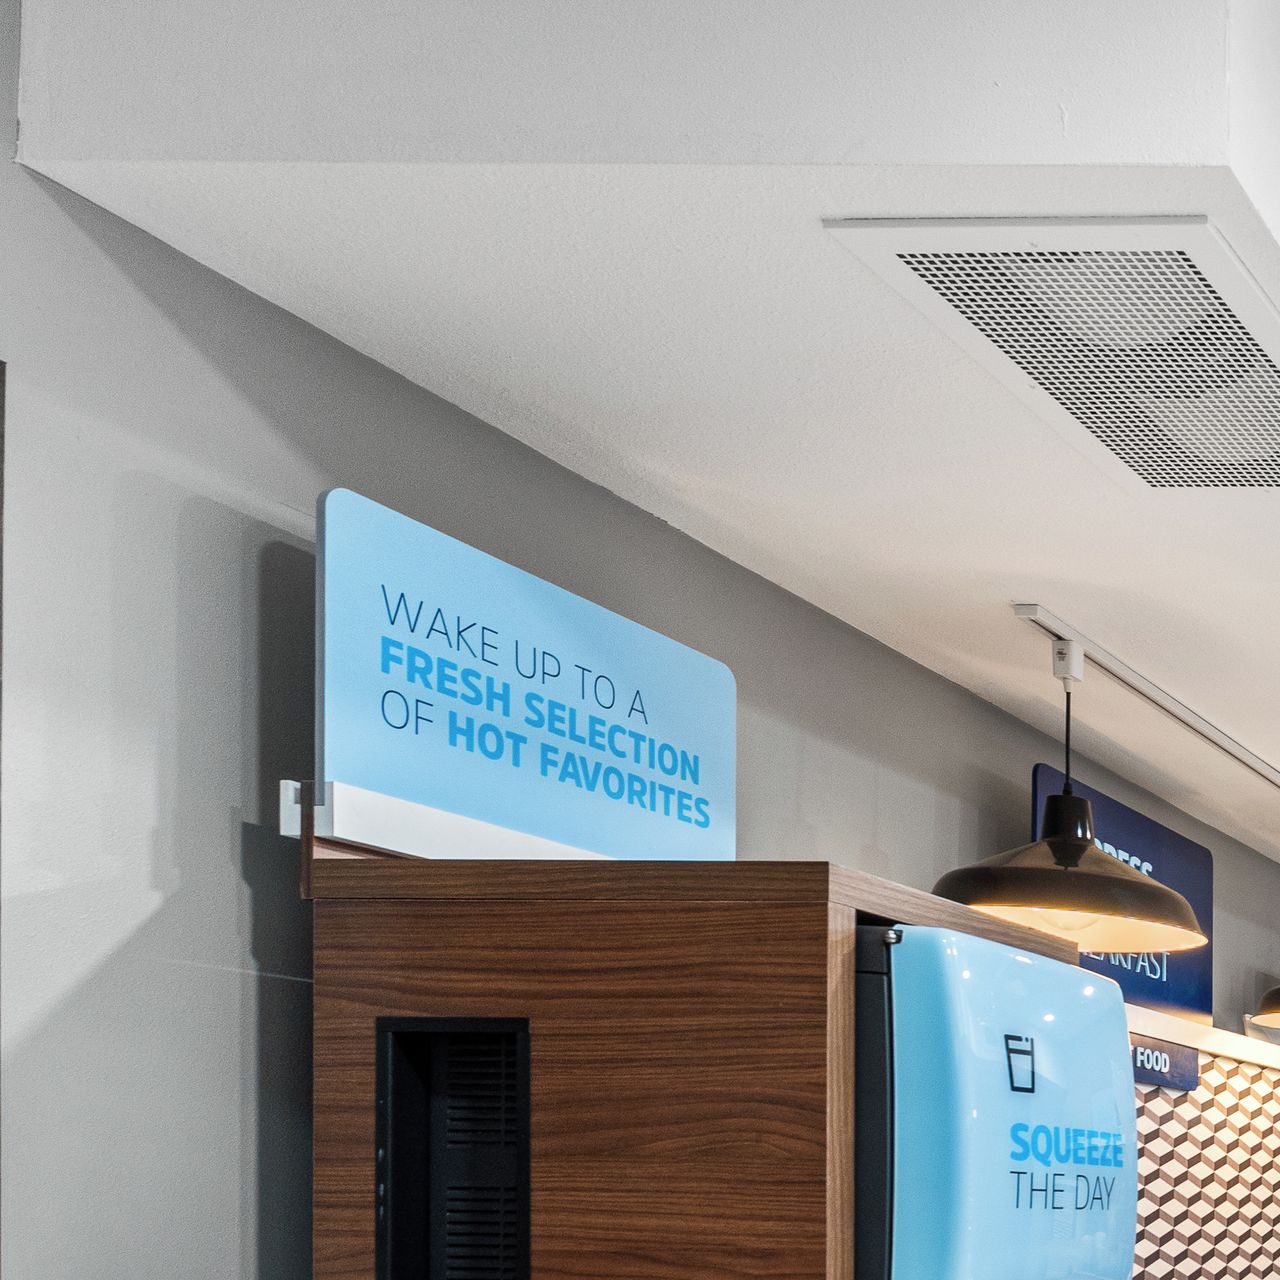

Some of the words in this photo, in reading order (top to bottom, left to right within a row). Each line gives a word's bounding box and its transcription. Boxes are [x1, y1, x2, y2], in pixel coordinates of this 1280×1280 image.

[381, 583, 499, 667] WAKE
[515, 639, 561, 685] UP
[574, 663, 616, 710] TO
[628, 689, 648, 725] A
[380, 635, 511, 718] FRESH
[524, 692, 700, 786] SELECTION
[381, 689, 434, 735] OF
[448, 710, 528, 768] HOT
[540, 742, 711, 829] FAVORITES
[1136, 1046, 1170, 1073] FOOD
[1009, 1171, 1065, 1210] THE
[1075, 1174, 1116, 1211] DAY
[1010, 1122, 1123, 1168] SQUEEZE
